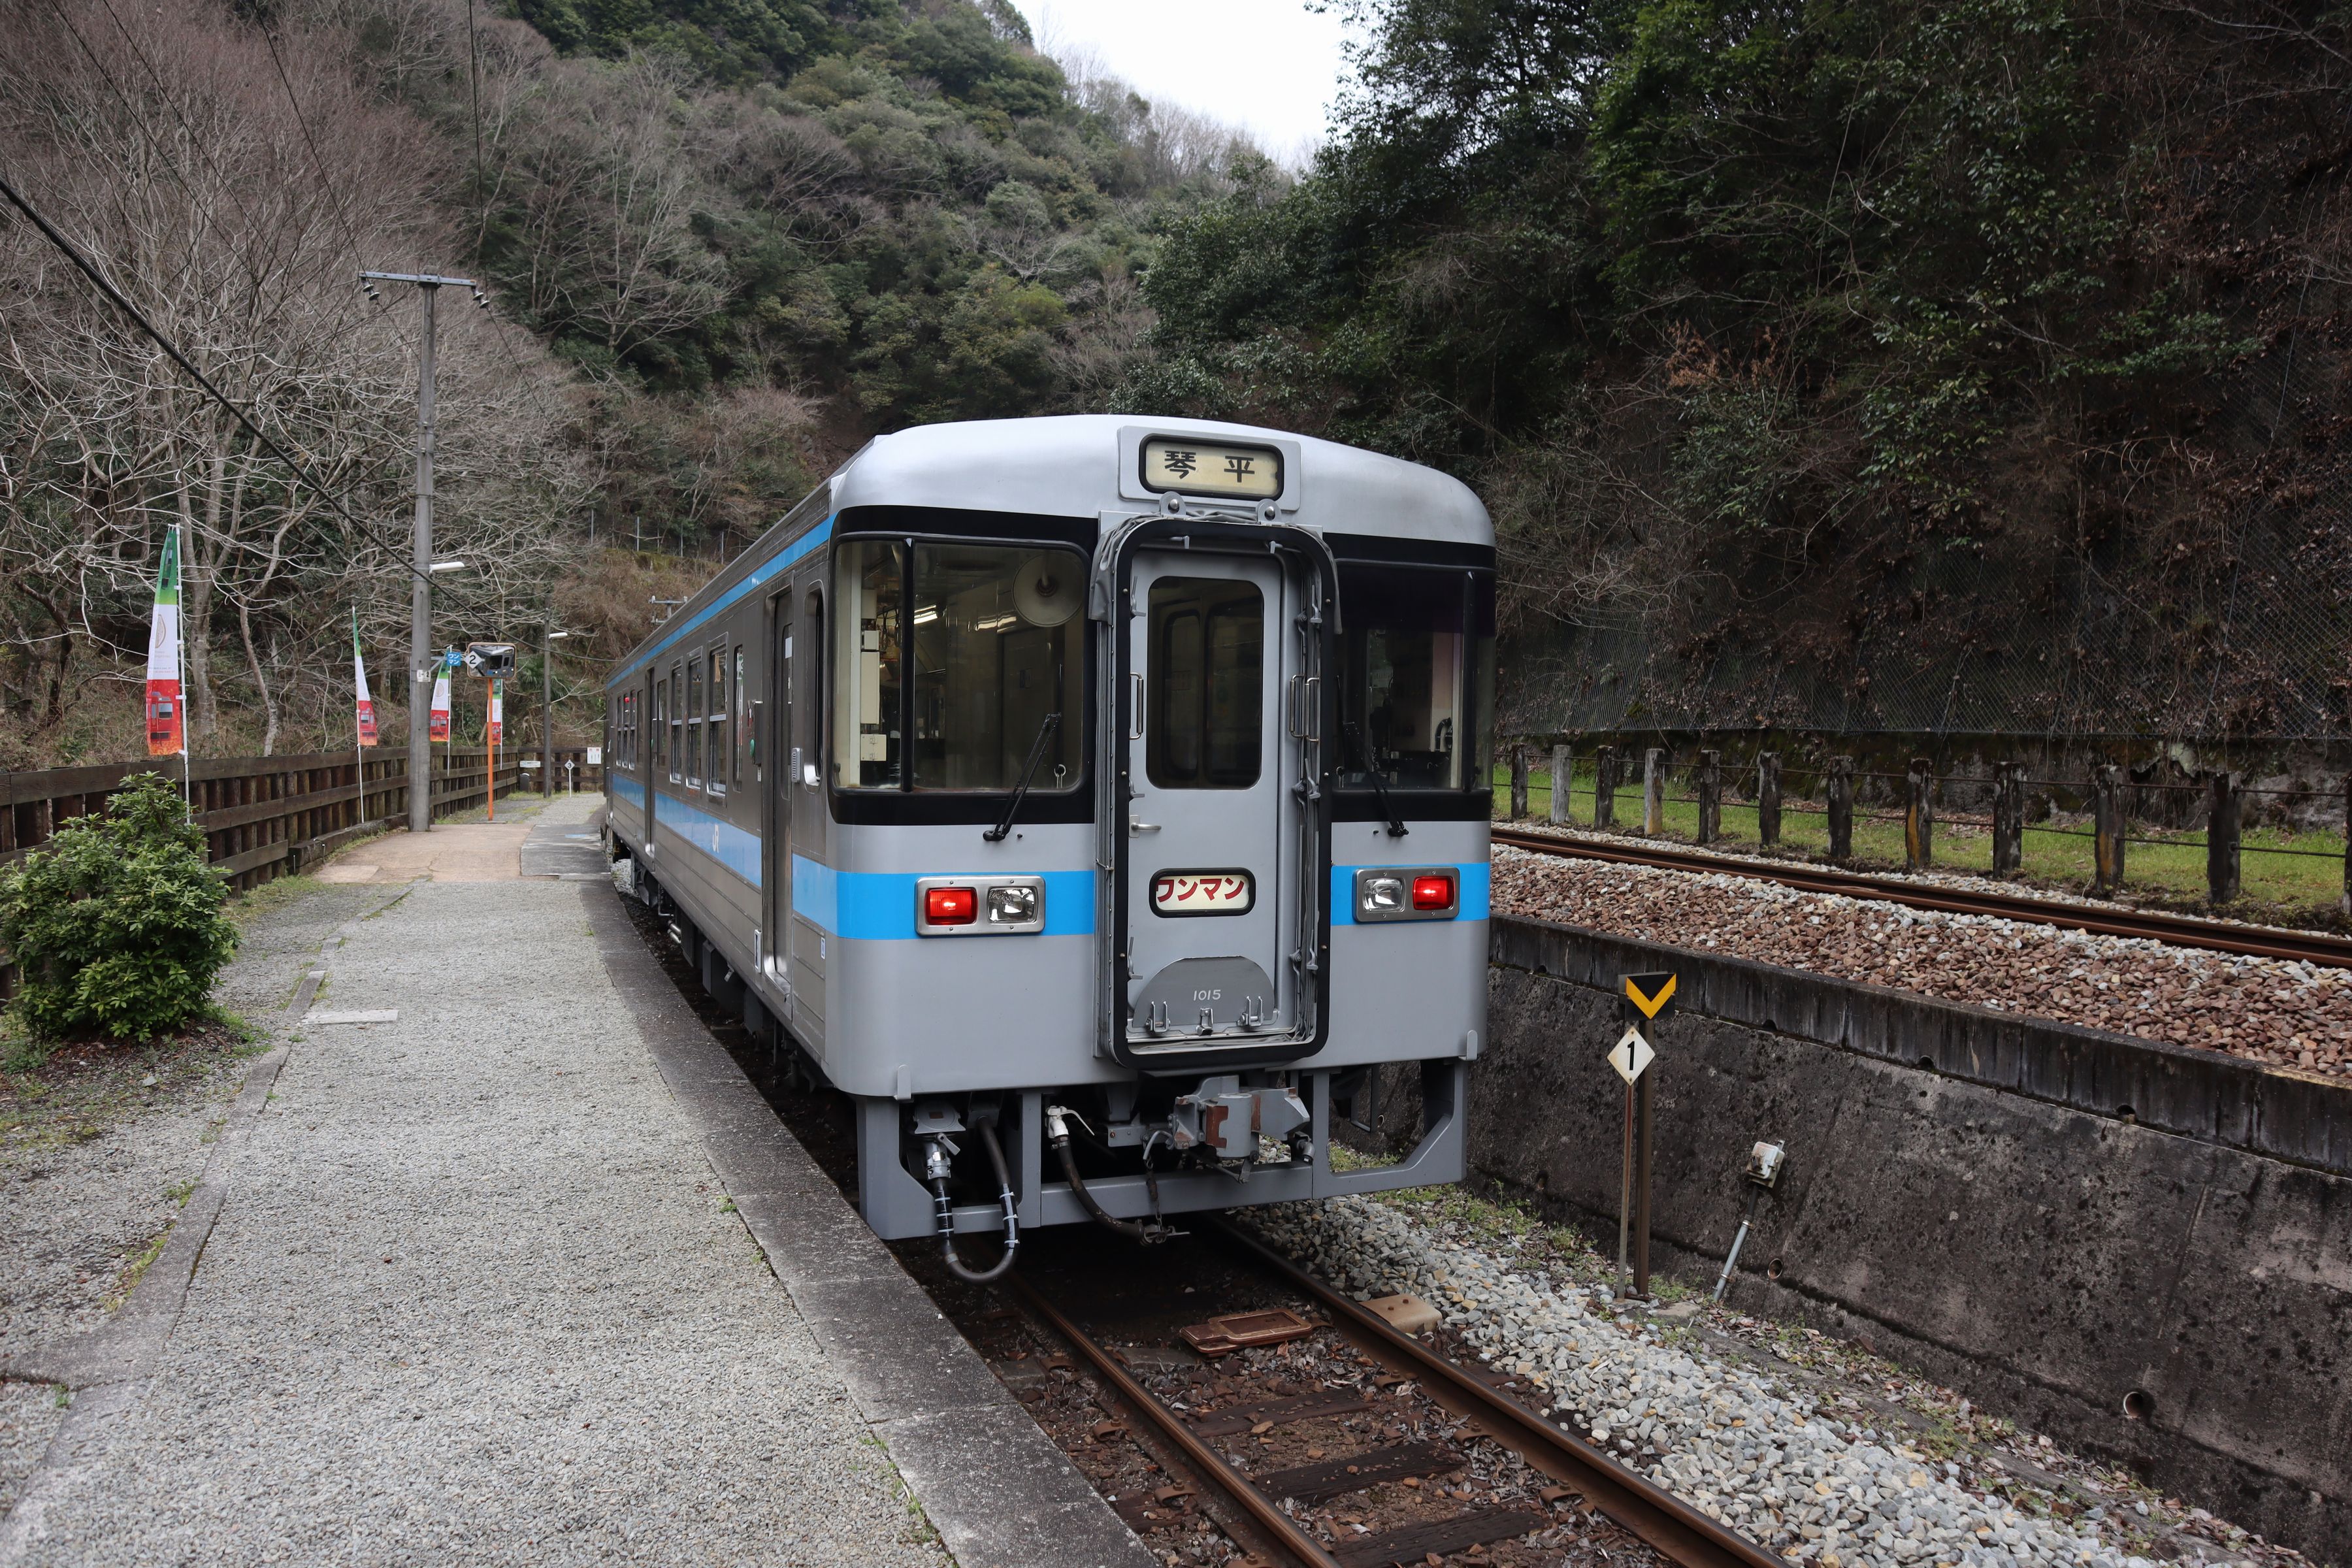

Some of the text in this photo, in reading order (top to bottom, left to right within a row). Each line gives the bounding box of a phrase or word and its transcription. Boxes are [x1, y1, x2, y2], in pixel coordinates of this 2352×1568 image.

[1164, 450, 1255, 483] 琴平
[469, 655, 476, 664] 2
[713, 824, 719, 853] JR
[1156, 877, 1245, 902] ワンマン
[1194, 989, 1221, 1001] 1015
[1627, 1041, 1635, 1071] 1
